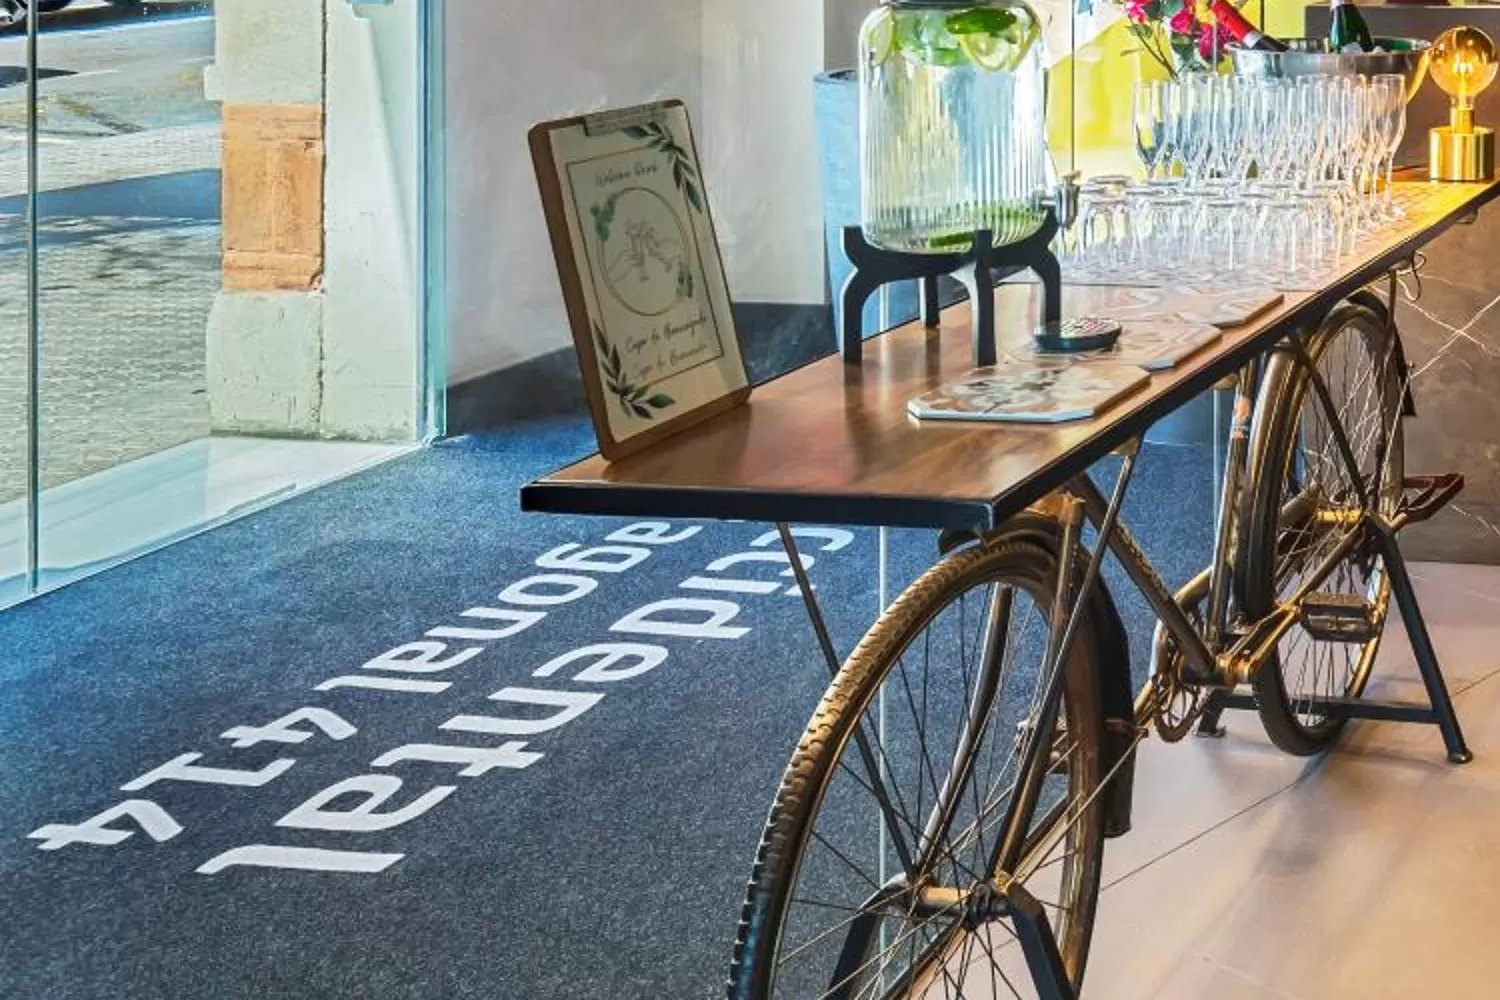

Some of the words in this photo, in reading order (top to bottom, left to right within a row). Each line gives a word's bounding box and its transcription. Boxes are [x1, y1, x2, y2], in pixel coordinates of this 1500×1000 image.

[313, 521, 703, 694] agonal
[27, 706, 358, 851] 414
[195, 527, 855, 874] ccidental
